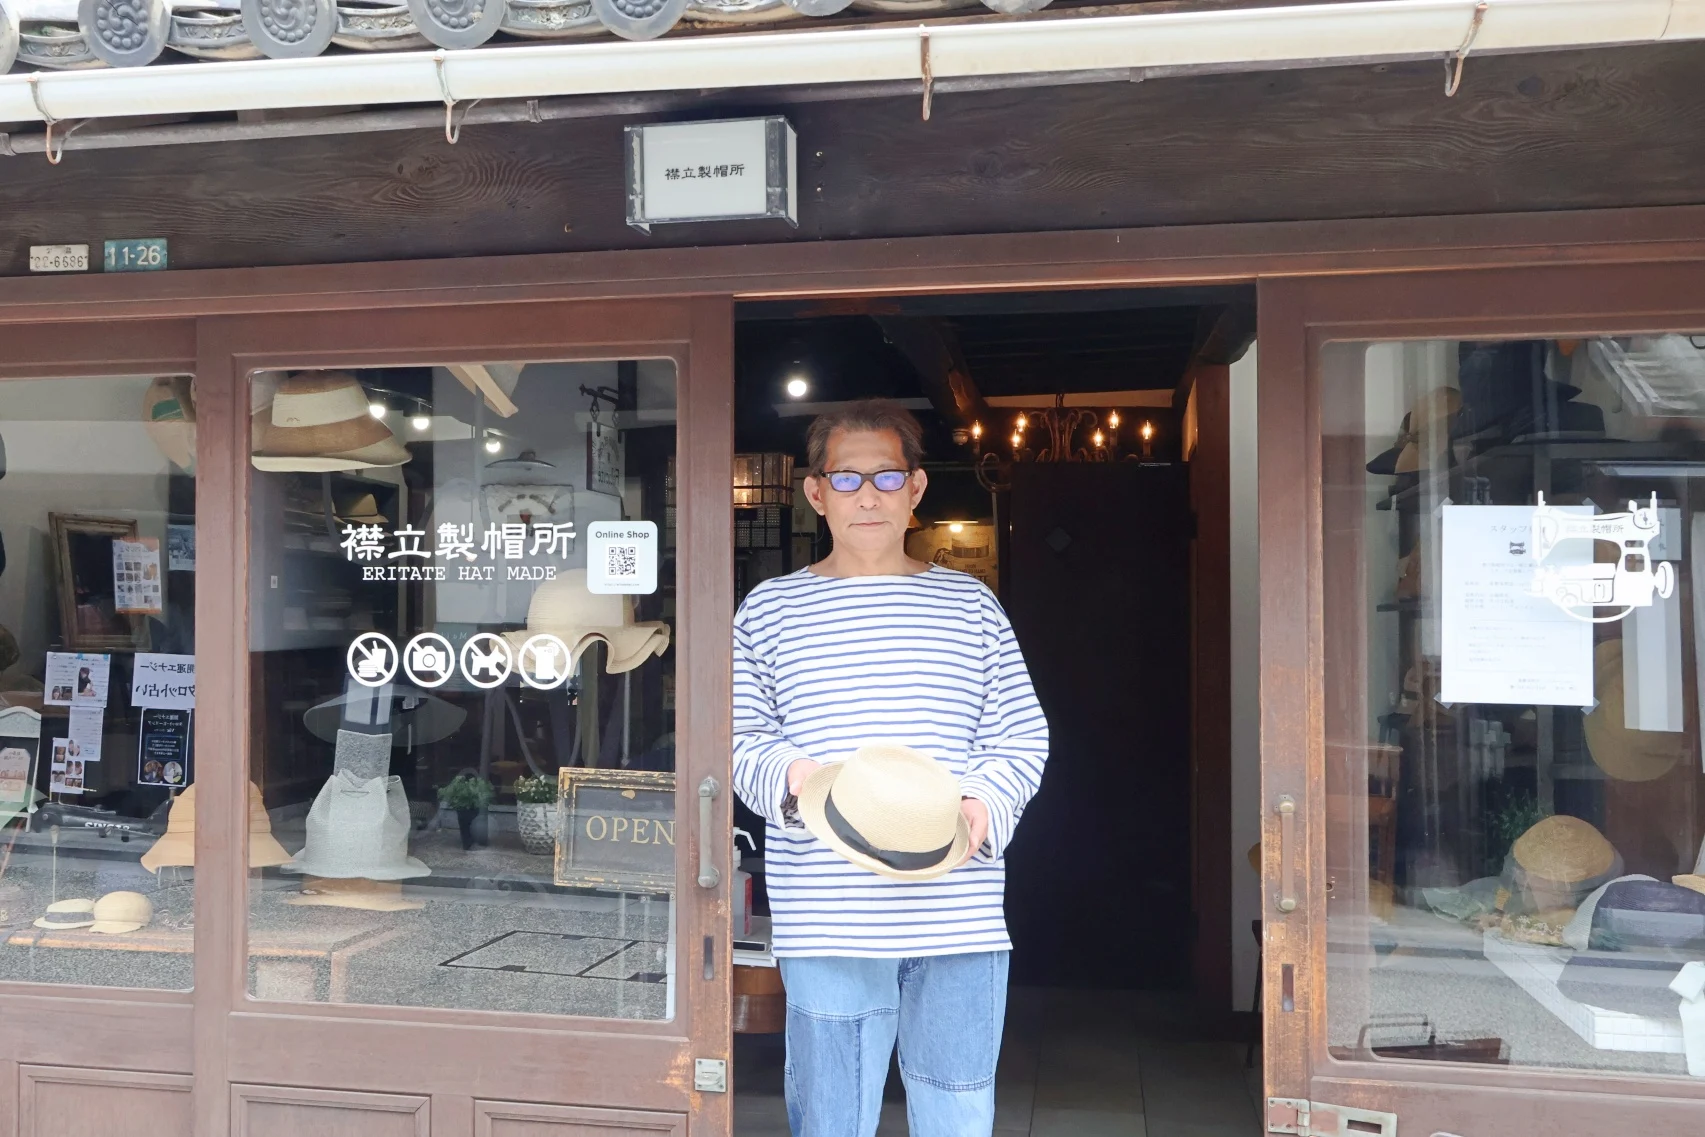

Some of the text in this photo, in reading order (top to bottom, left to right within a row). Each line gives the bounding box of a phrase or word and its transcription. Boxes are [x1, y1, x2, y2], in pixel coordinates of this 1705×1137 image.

[664, 163, 746, 181] 襟立製帽所
[108, 245, 161, 266] 11-26
[340, 522, 577, 561] 襟立製帽所
[595, 530, 650, 540] Online Shop
[362, 566, 557, 581] ERITATE HAT MADE
[586, 815, 676, 846] OPEN
